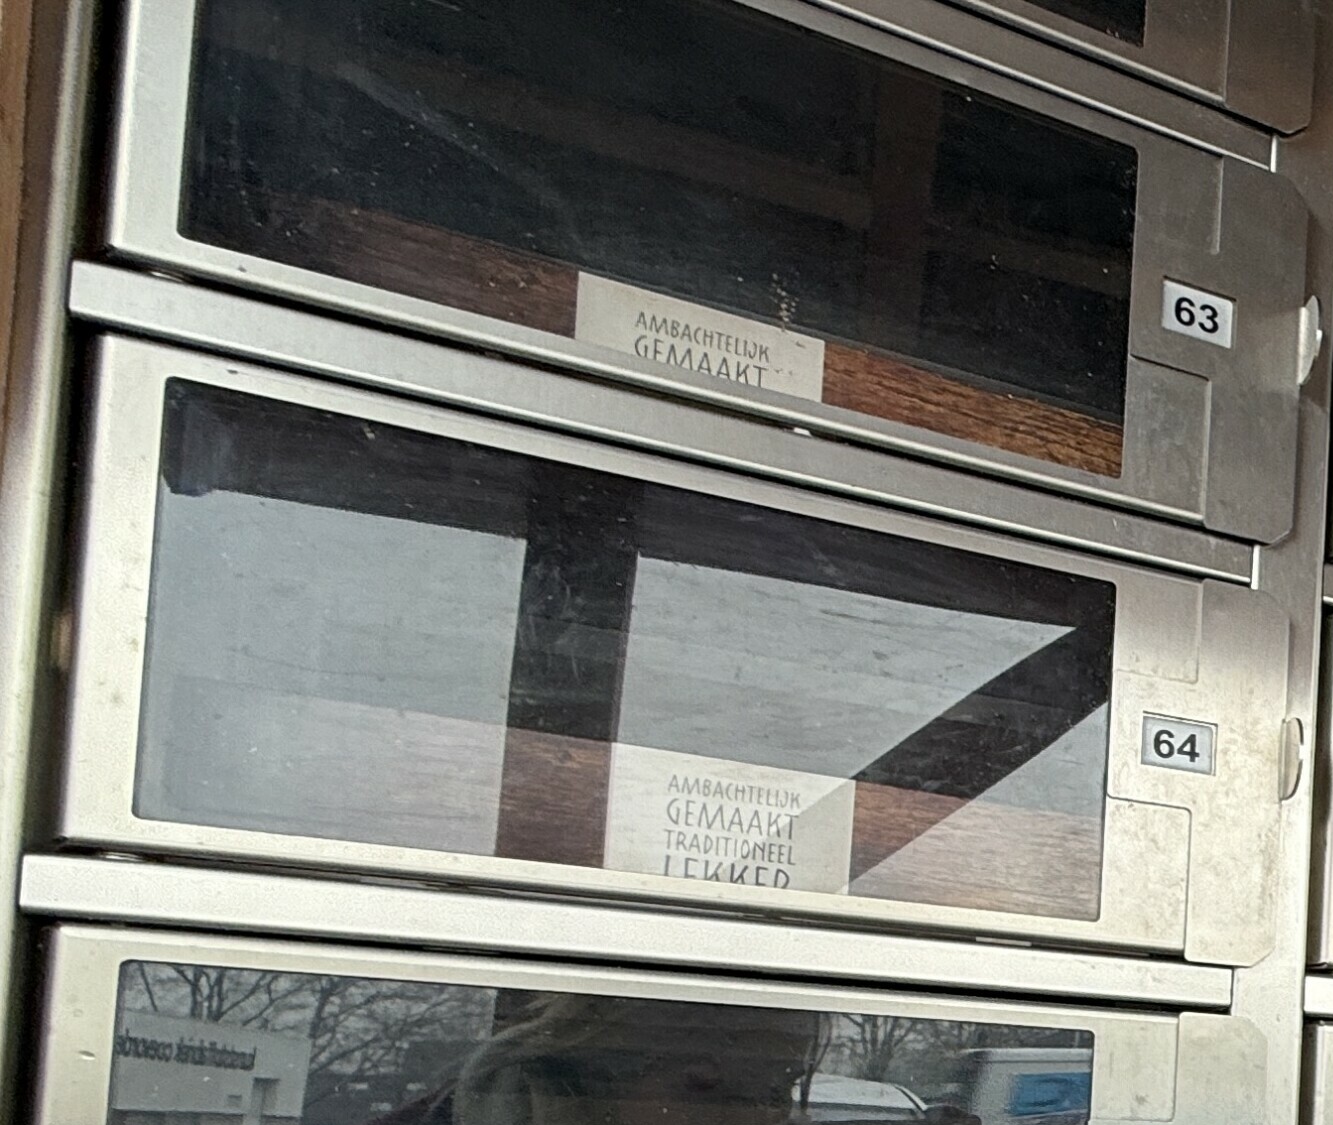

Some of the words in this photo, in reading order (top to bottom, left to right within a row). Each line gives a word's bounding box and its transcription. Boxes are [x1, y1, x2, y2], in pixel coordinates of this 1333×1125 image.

[1174, 296, 1219, 334] 63
[635, 311, 769, 363] AMBACHTELIJK
[634, 335, 768, 388] GEMAAKT
[1153, 729, 1200, 763] 64
[668, 774, 801, 809] AMBACHTELIJK
[667, 798, 799, 840] GEMAAKT
[664, 829, 796, 865] TRADITIONEEL
